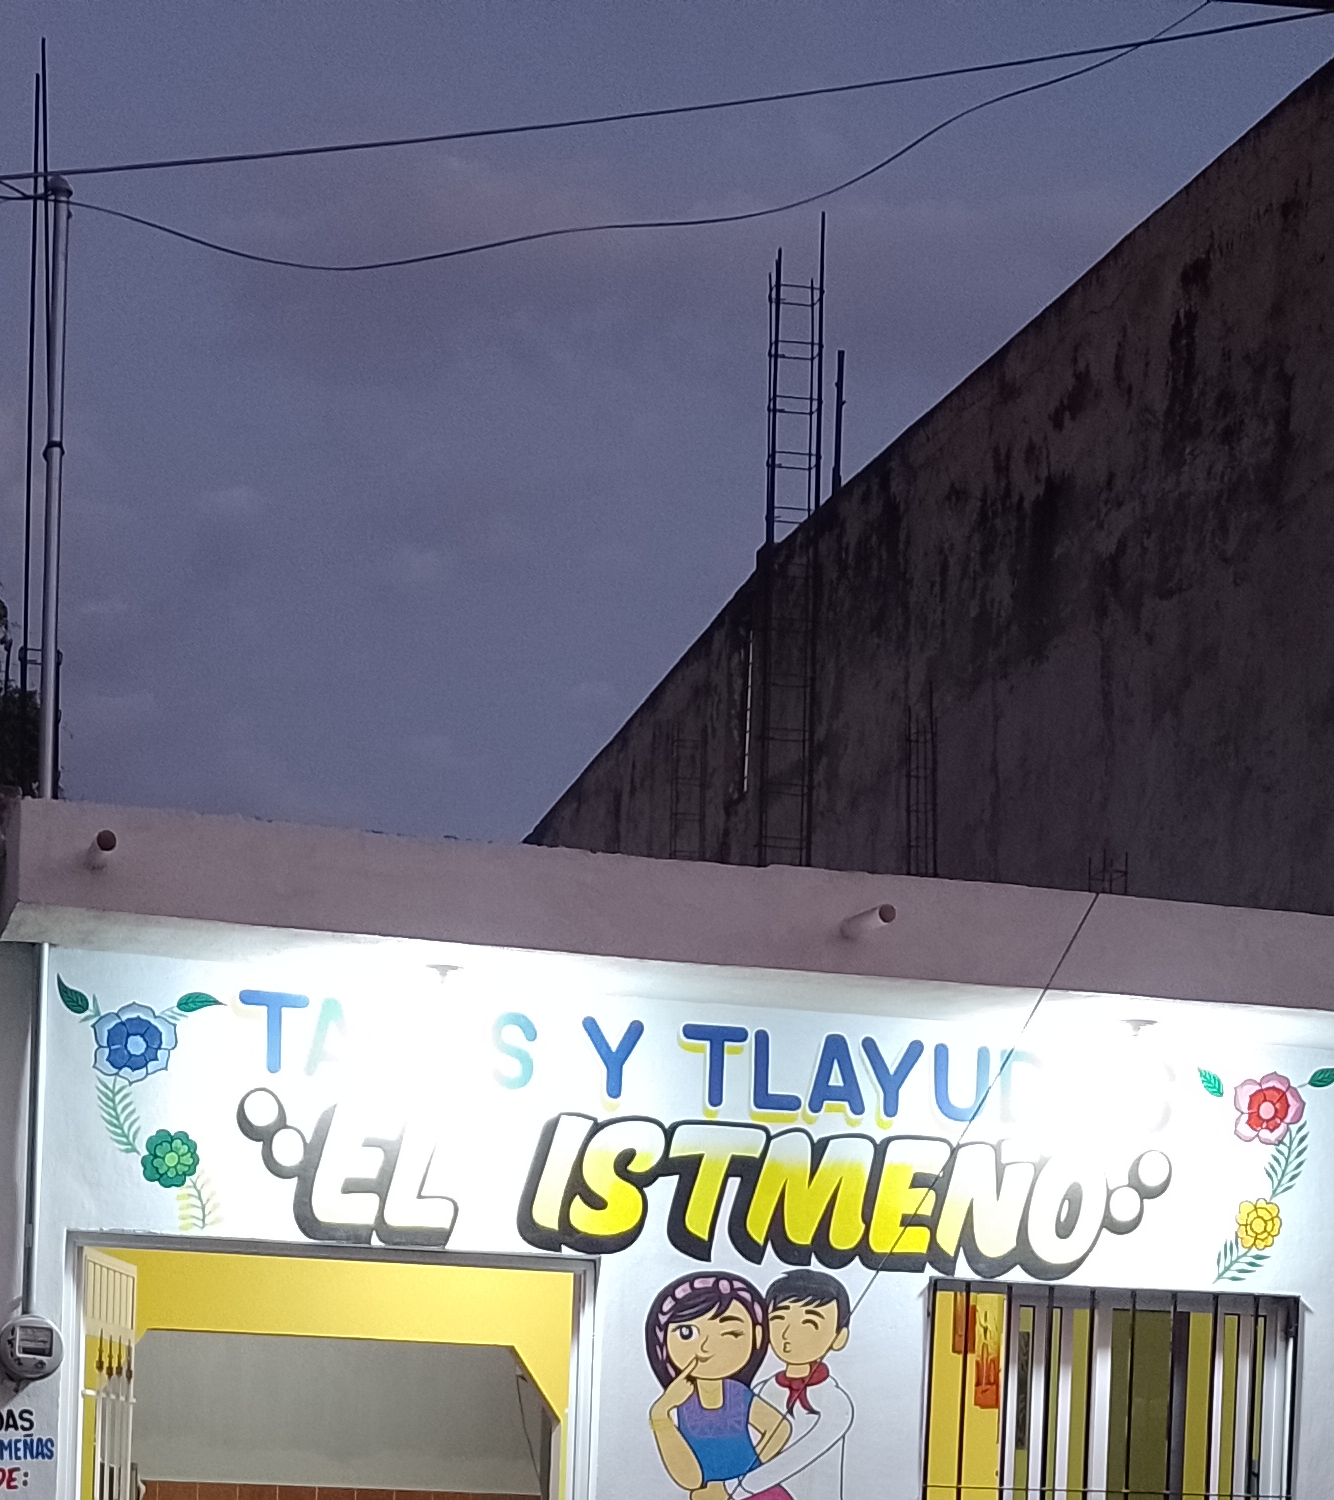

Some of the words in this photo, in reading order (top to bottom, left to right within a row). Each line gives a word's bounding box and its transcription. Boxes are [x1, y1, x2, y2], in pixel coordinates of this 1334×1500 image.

[238, 988, 538, 1090] TAS
[581, 1014, 644, 1100] Y
[680, 1022, 1175, 1131] TLAYUD
[293, 1103, 459, 1247] EL
